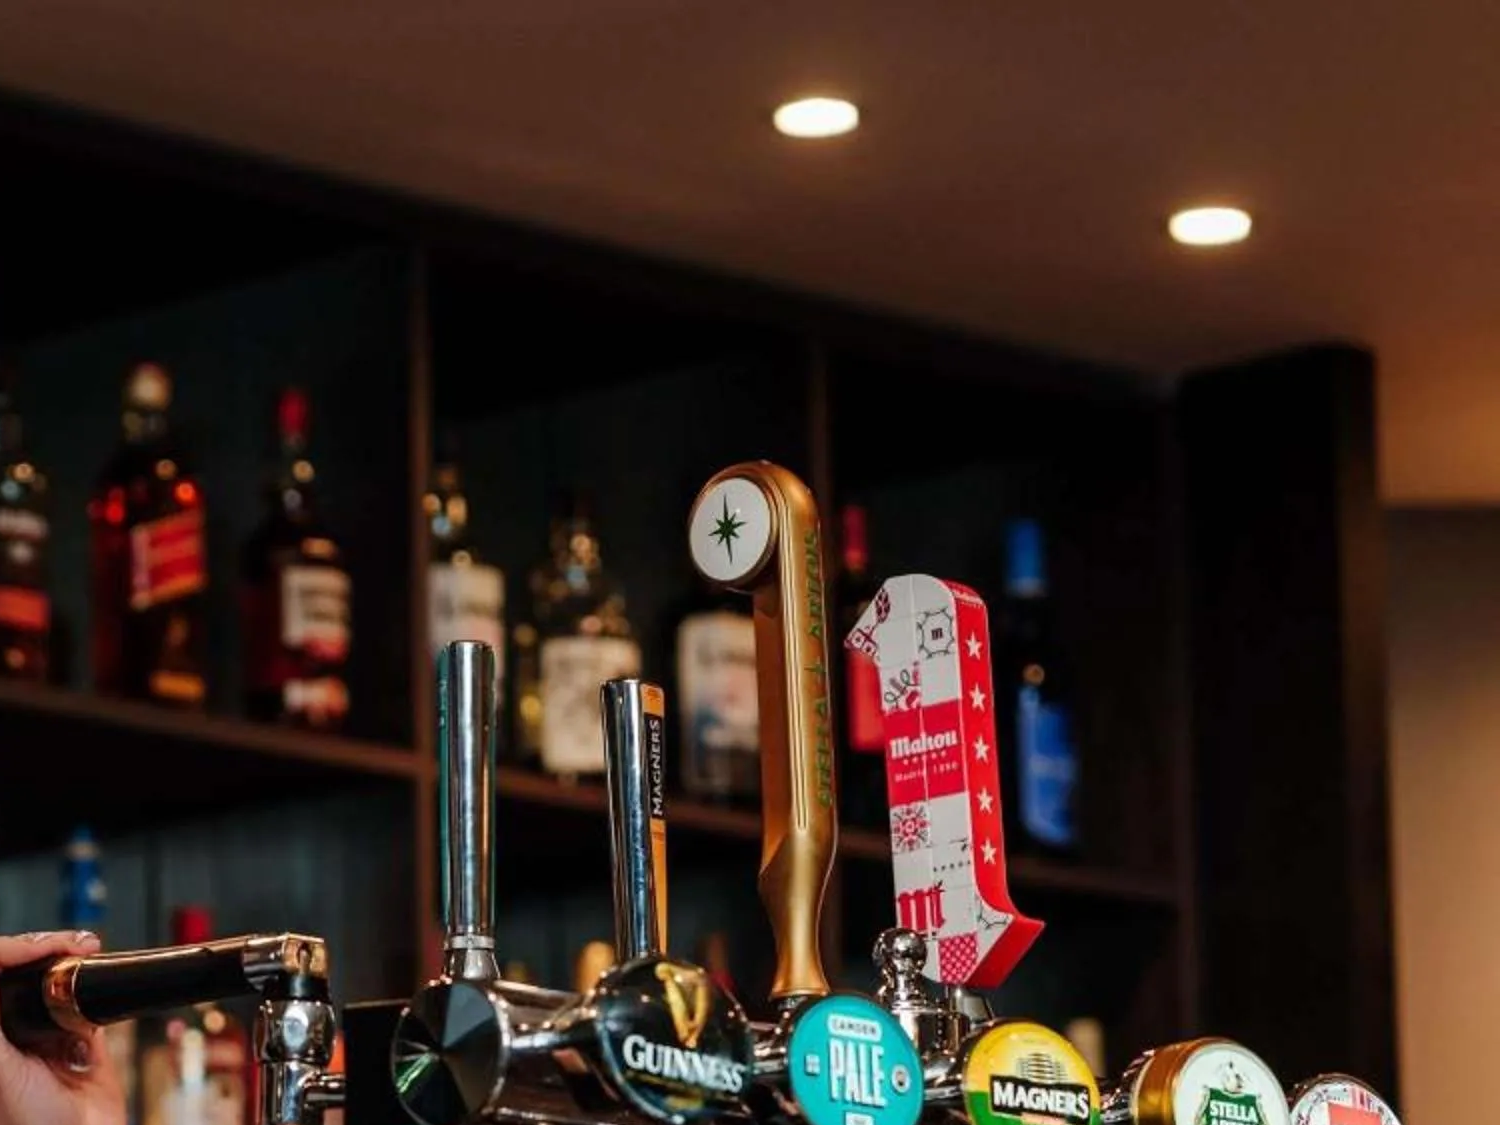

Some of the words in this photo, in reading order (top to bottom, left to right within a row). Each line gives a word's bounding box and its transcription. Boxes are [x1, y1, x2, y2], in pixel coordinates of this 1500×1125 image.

[889, 730, 958, 759] Mahou
[649, 719, 663, 816] MAGNERS
[832, 1020, 877, 1036] CAMDEN
[622, 1034, 747, 1094] GUINNESS
[829, 1037, 887, 1108] PALE
[992, 1080, 1089, 1120] MAGNERS
[1209, 1100, 1258, 1121] STELLA
